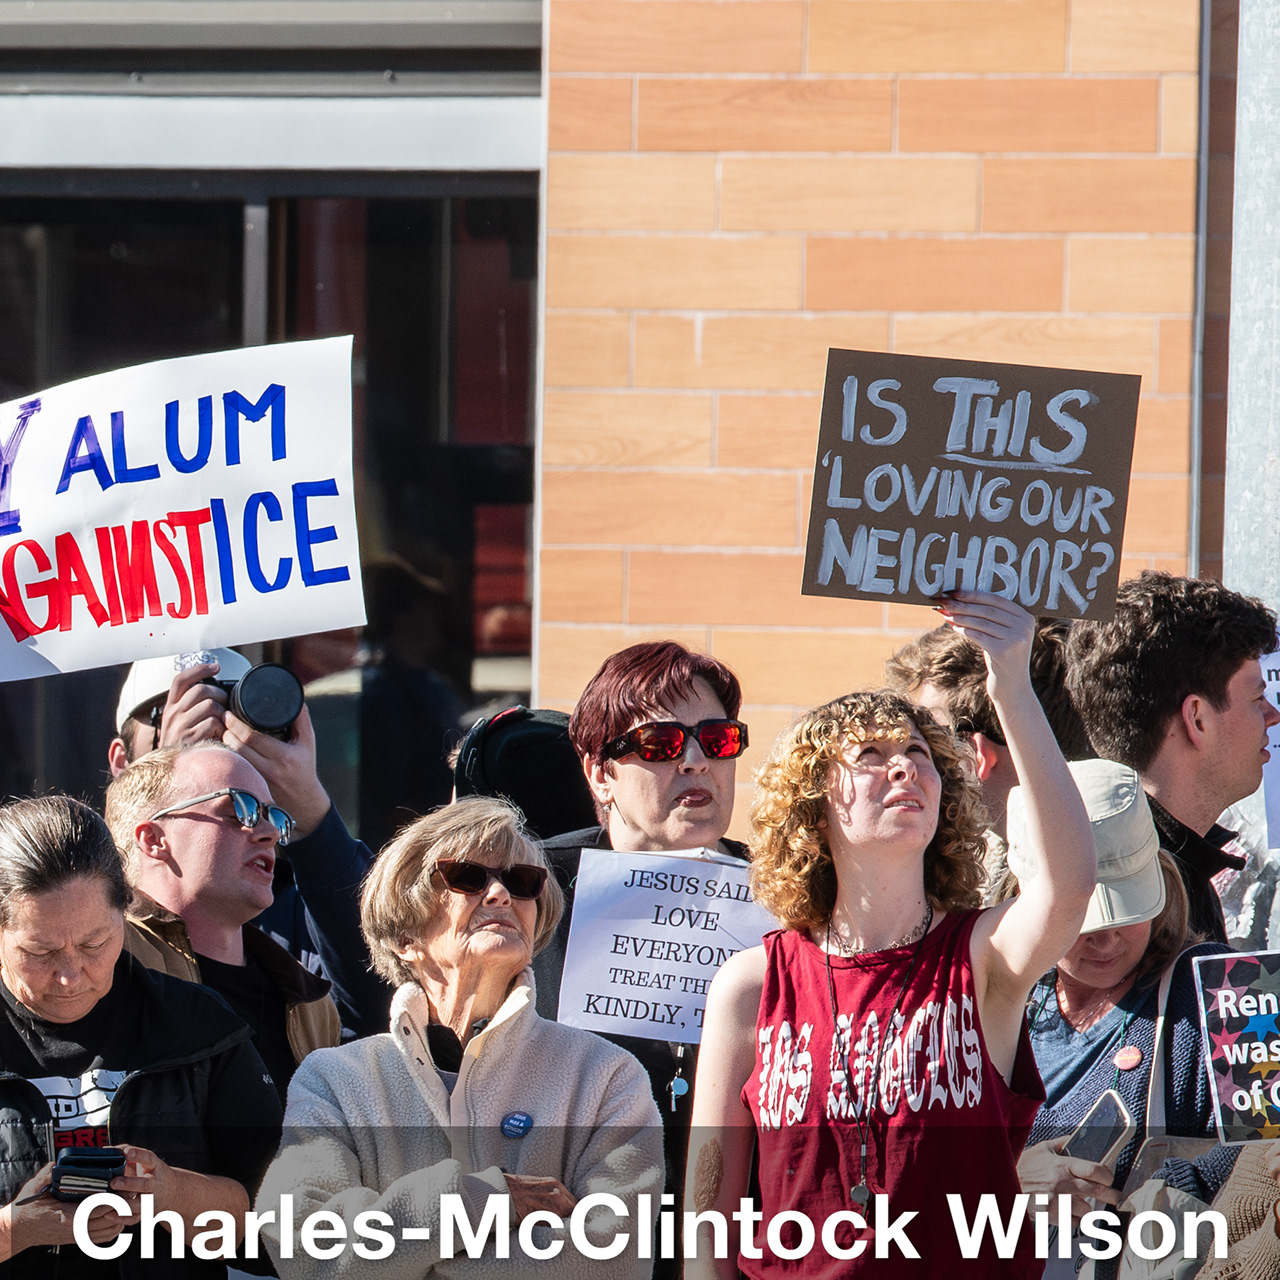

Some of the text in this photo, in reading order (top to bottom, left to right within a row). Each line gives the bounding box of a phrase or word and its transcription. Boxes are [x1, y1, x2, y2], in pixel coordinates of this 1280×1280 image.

[842, 375, 1093, 465] IS THIS
[55, 383, 287, 496] ALUM
[1020, 479, 1116, 535] OUR
[210, 477, 351, 605] ICE
[624, 869, 699, 895] JESUS
[652, 905, 720, 931] LOVE
[610, 934, 740, 967] EVERYON
[609, 967, 712, 995] TREAT TH
[583, 993, 686, 1029] KINDLY,
[1217, 990, 1279, 1019] Ren
[1232, 1080, 1263, 1111] of
